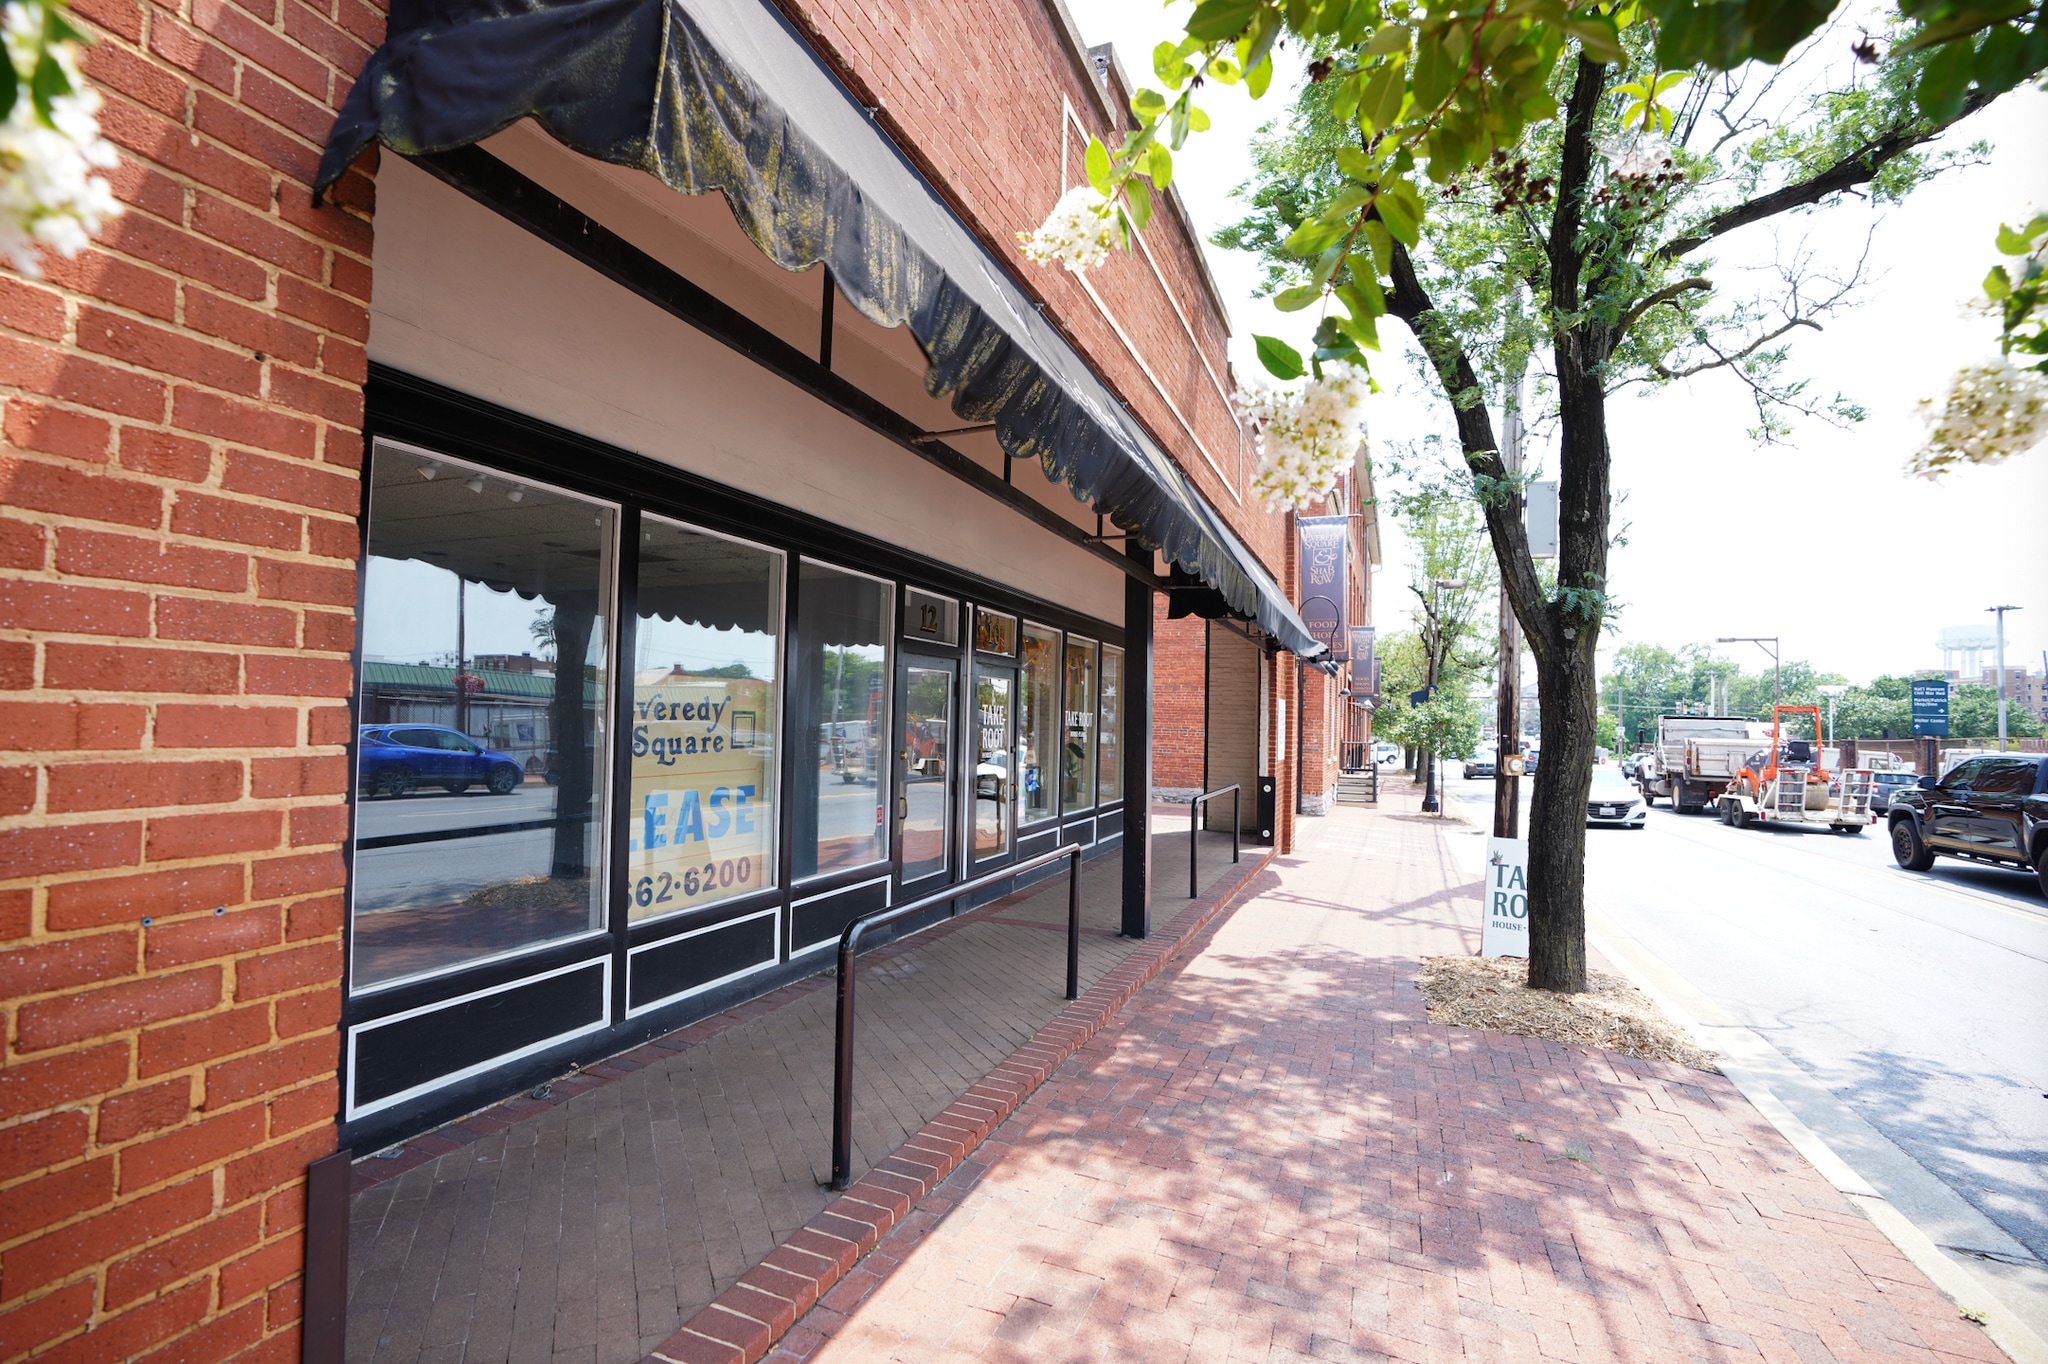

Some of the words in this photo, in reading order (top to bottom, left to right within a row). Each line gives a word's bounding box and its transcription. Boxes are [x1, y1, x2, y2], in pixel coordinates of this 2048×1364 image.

[1305, 540, 1340, 550] SQUARE
[1310, 565, 1335, 575] SHAB
[1310, 574, 1335, 585] ROW
[920, 603, 938, 633] 12
[1309, 621, 1337, 629] FOOD
[987, 618, 1001, 645] 10
[1312, 631, 1339, 639] HOPS
[633, 694, 731, 733] veredy
[982, 704, 1004, 726] TAKE
[1065, 710, 1078, 727] TAKE
[1079, 711, 1094, 728] ROOT
[632, 725, 725, 766] Square
[982, 728, 1004, 749] ROOT
[629, 785, 756, 852] EASE
[1492, 863, 1527, 891] TA
[1493, 891, 1528, 919] RO
[1492, 920, 1523, 931] HOUSE
